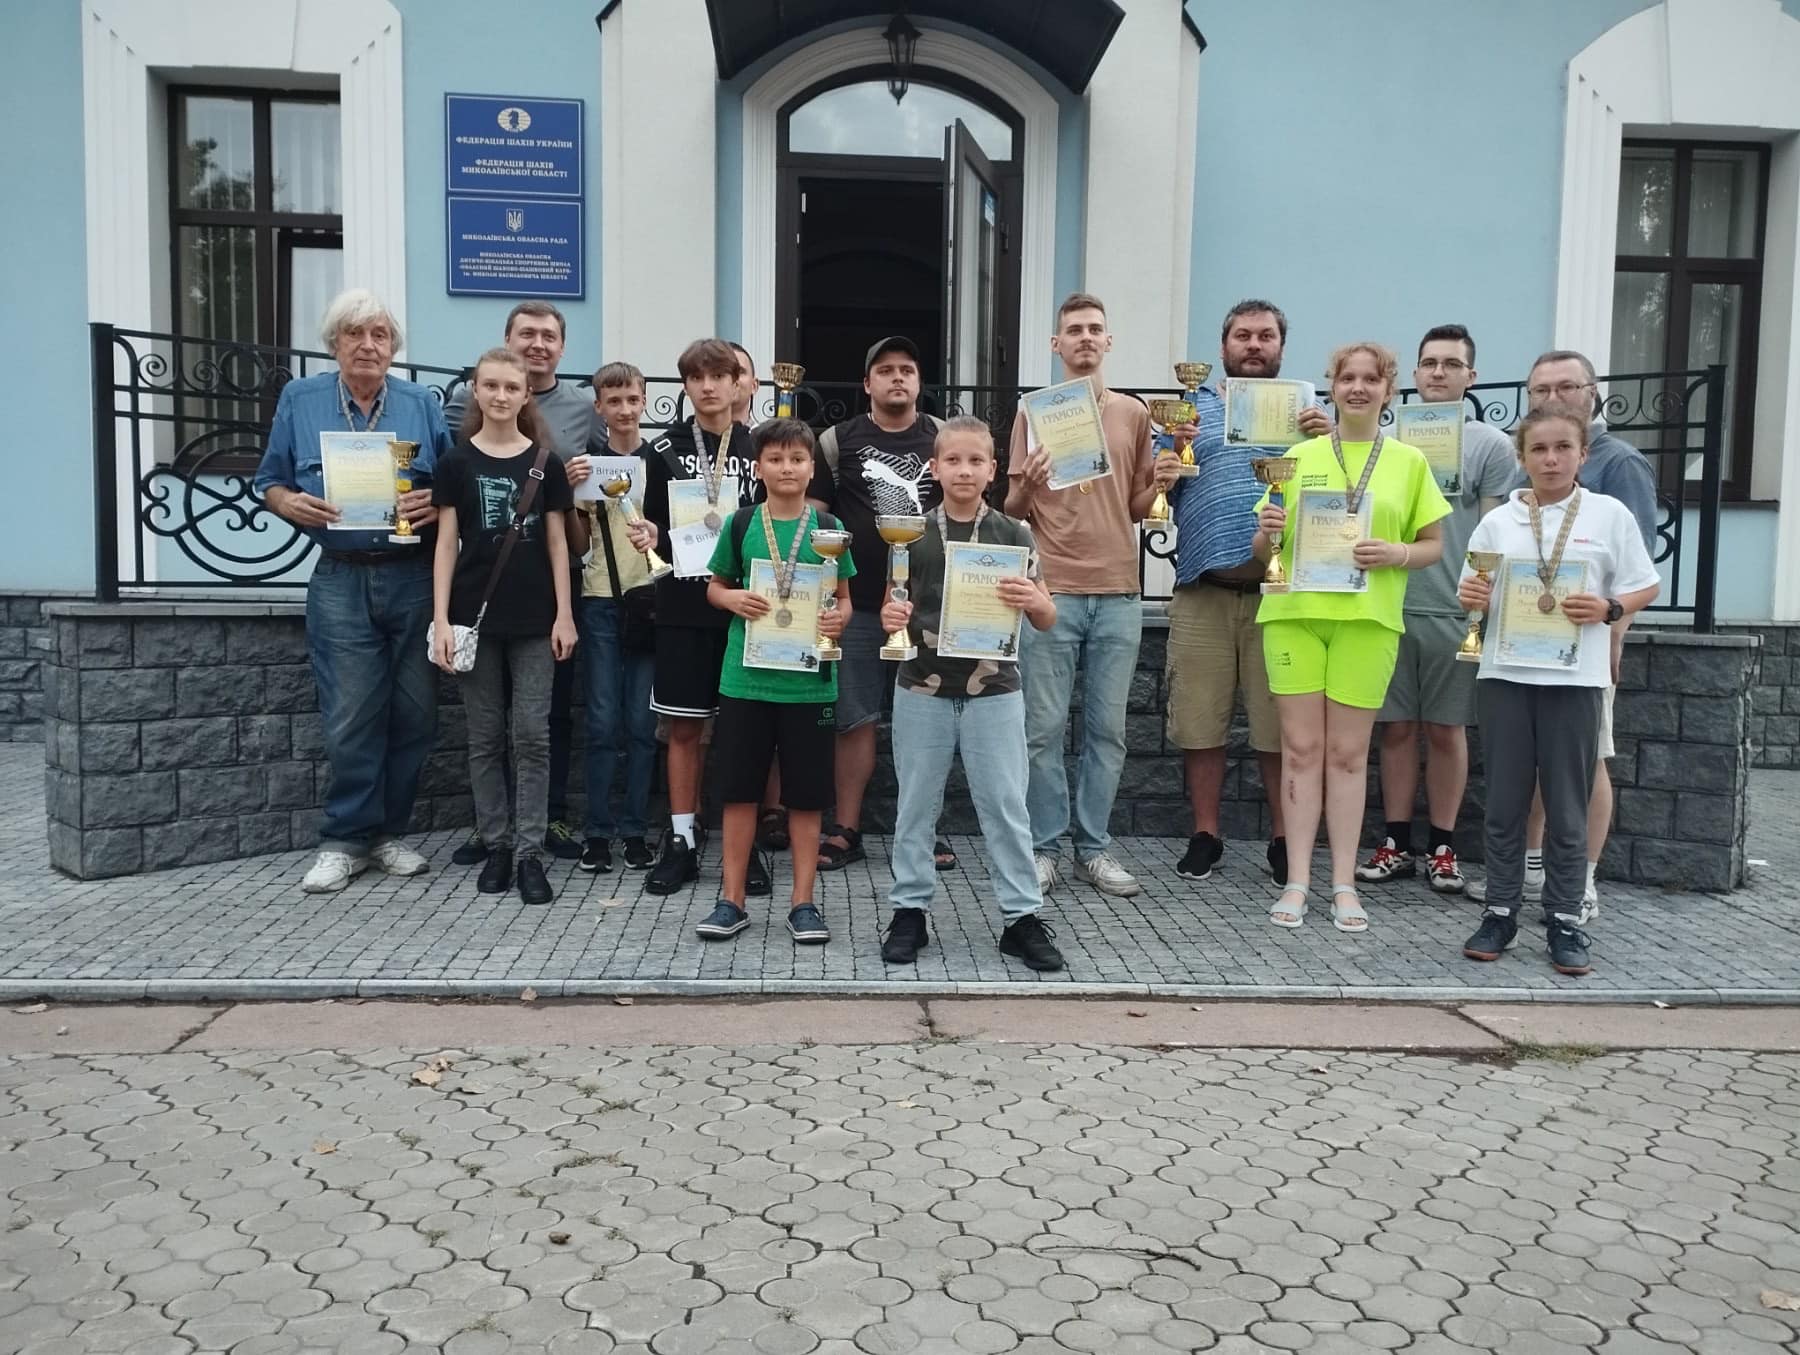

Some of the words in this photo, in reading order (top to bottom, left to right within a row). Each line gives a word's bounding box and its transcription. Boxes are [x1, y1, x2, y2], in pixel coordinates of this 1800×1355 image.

[456, 136, 504, 146] ФЕДЕРАЦІЯ
[507, 138, 534, 147] ШАХІВ
[536, 139, 573, 149] УКРАЇНИ
[475, 159, 524, 168] ФЕДЕРАЦІЯ
[526, 160, 554, 169] ШАХІВ
[532, 169, 568, 178] ОБЛАСТІ
[550, 237, 568, 245] РАДА
[1042, 406, 1085, 424] ГРАМОТА
[1408, 426, 1451, 437] ГРАМОТА
[961, 572, 999, 585] ГРАМО
